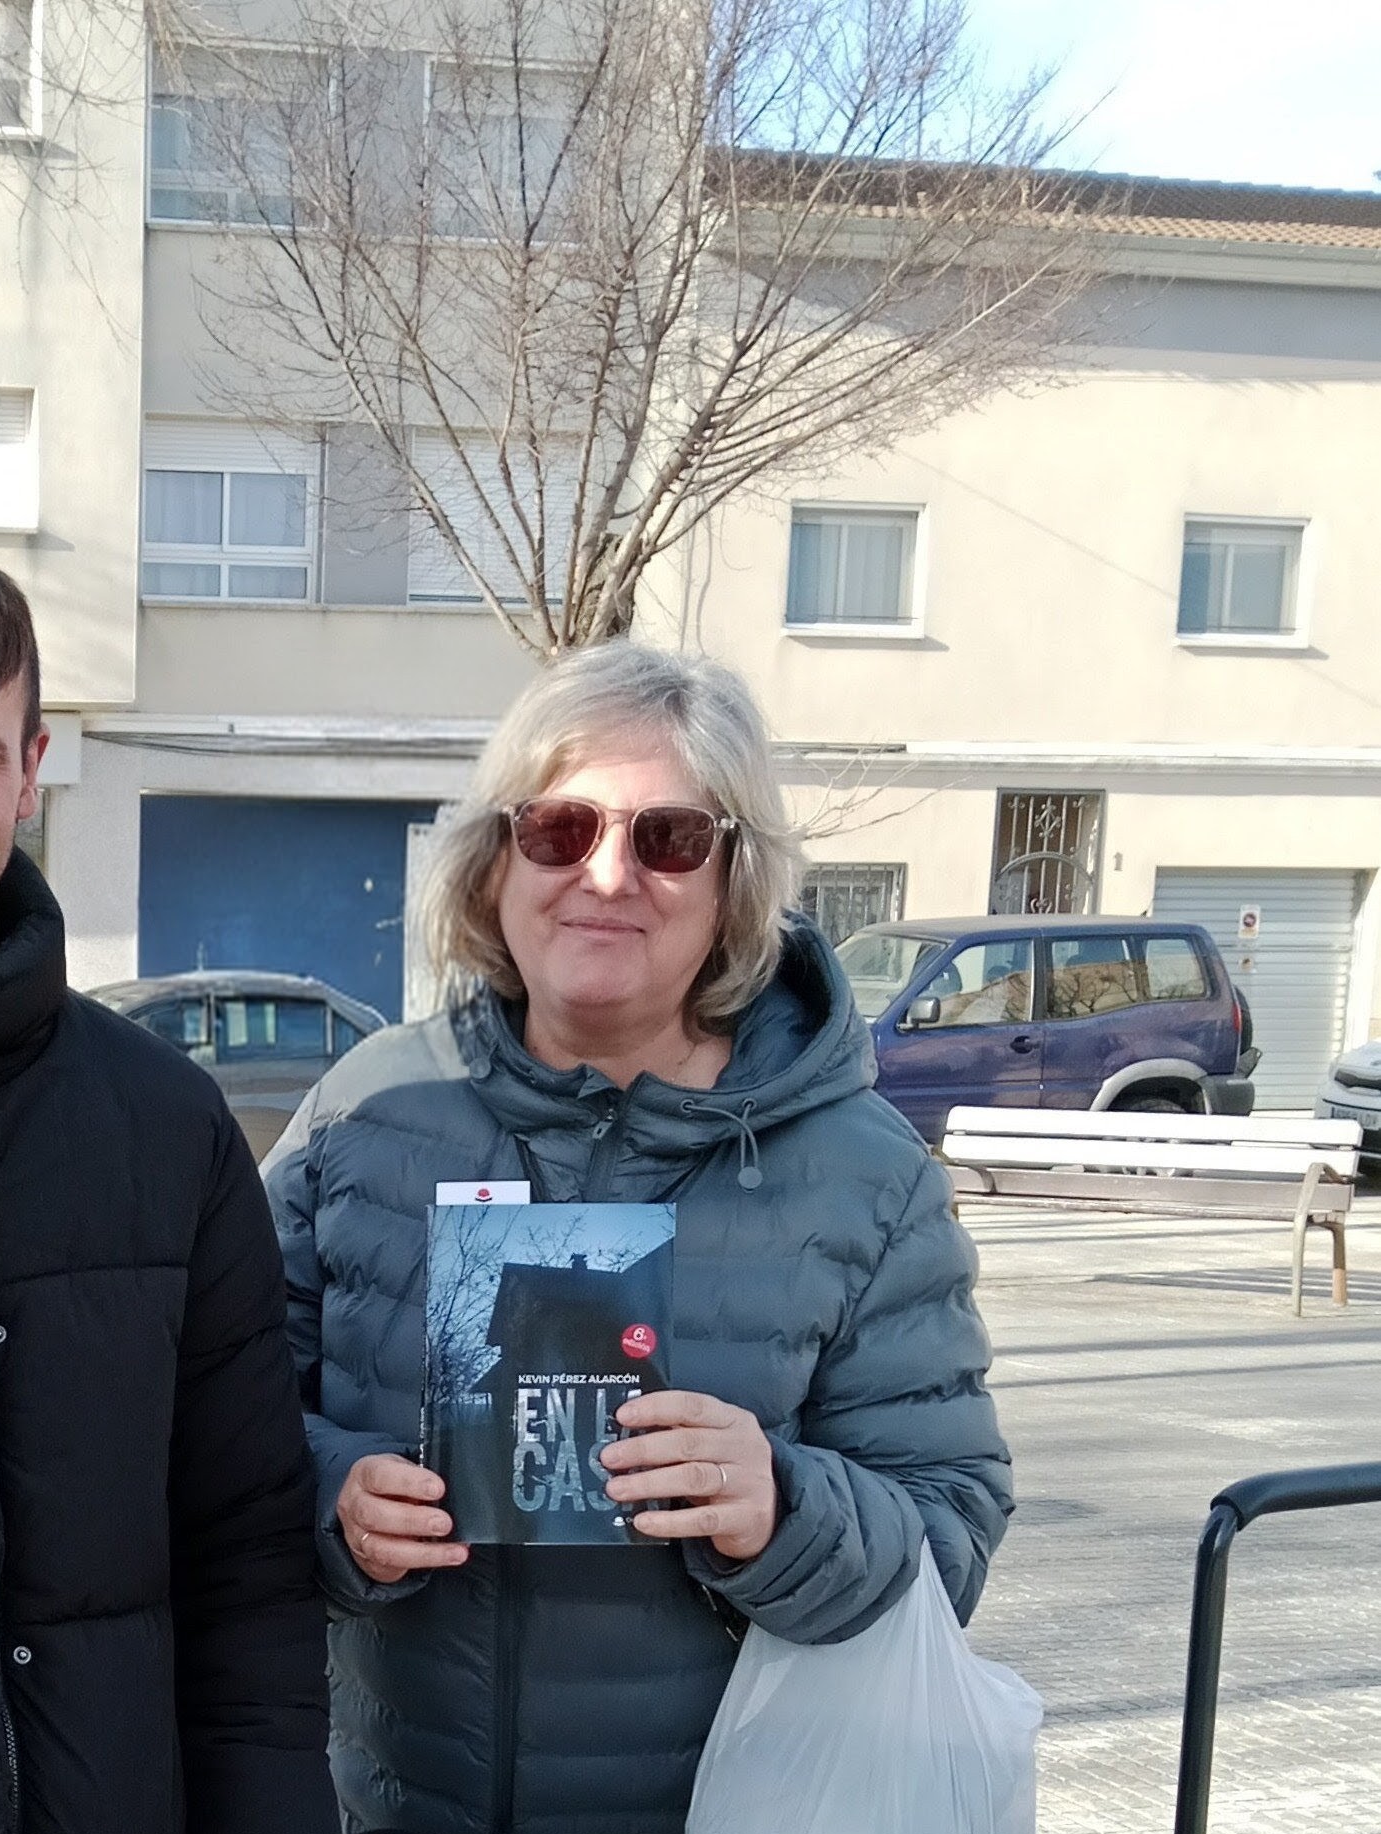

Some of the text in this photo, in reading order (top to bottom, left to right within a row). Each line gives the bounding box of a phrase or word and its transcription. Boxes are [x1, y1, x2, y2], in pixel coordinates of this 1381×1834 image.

[518, 1372, 640, 1384] KEVIN PÉREZ ALARCÓN
[517, 1388, 576, 1442] EN
